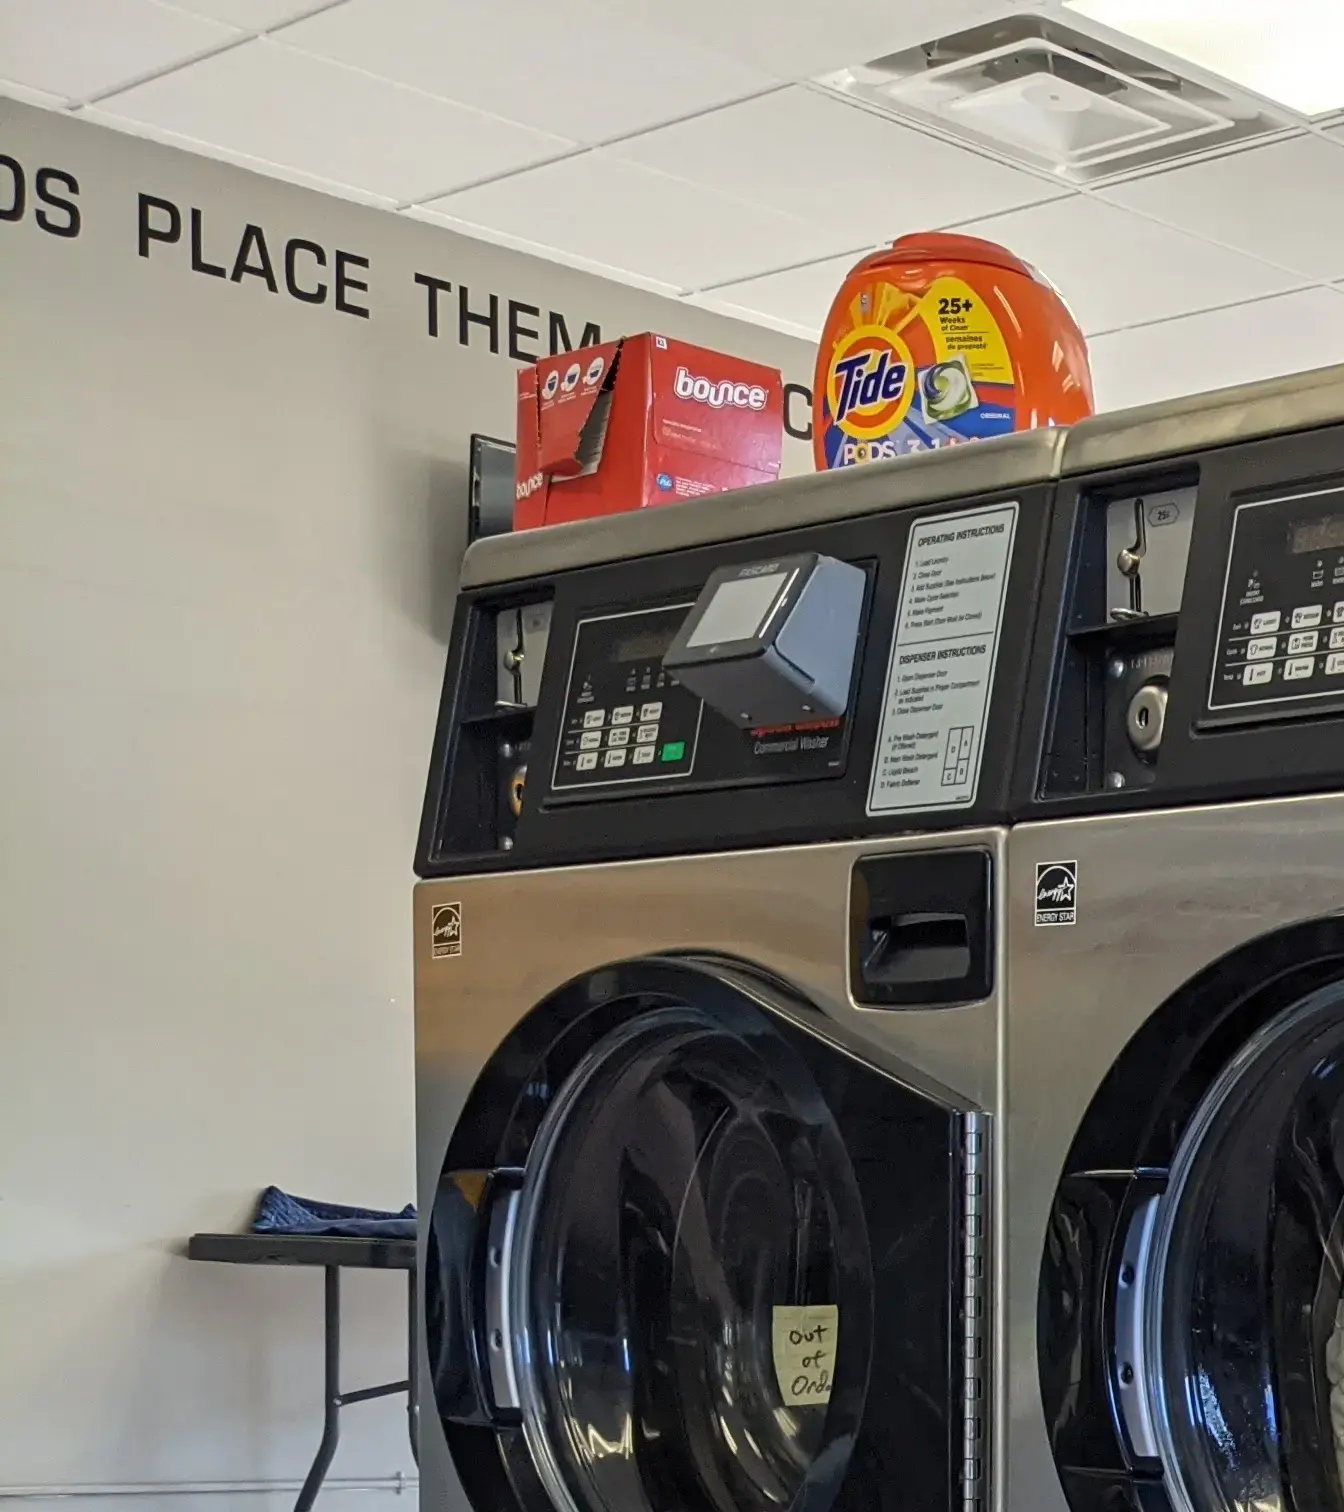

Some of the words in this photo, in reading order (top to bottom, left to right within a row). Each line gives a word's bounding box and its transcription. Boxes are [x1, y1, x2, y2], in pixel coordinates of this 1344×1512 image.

[138, 192, 370, 320] PLACE
[414, 272, 600, 364] THEM
[938, 297, 973, 315] 25+
[940, 316, 965, 324] Weeks
[946, 335, 983, 343] semaines
[674, 367, 767, 410] bounce
[834, 350, 908, 425] Tide
[980, 412, 1011, 420] ORIGINAL
[843, 440, 897, 466] PODS
